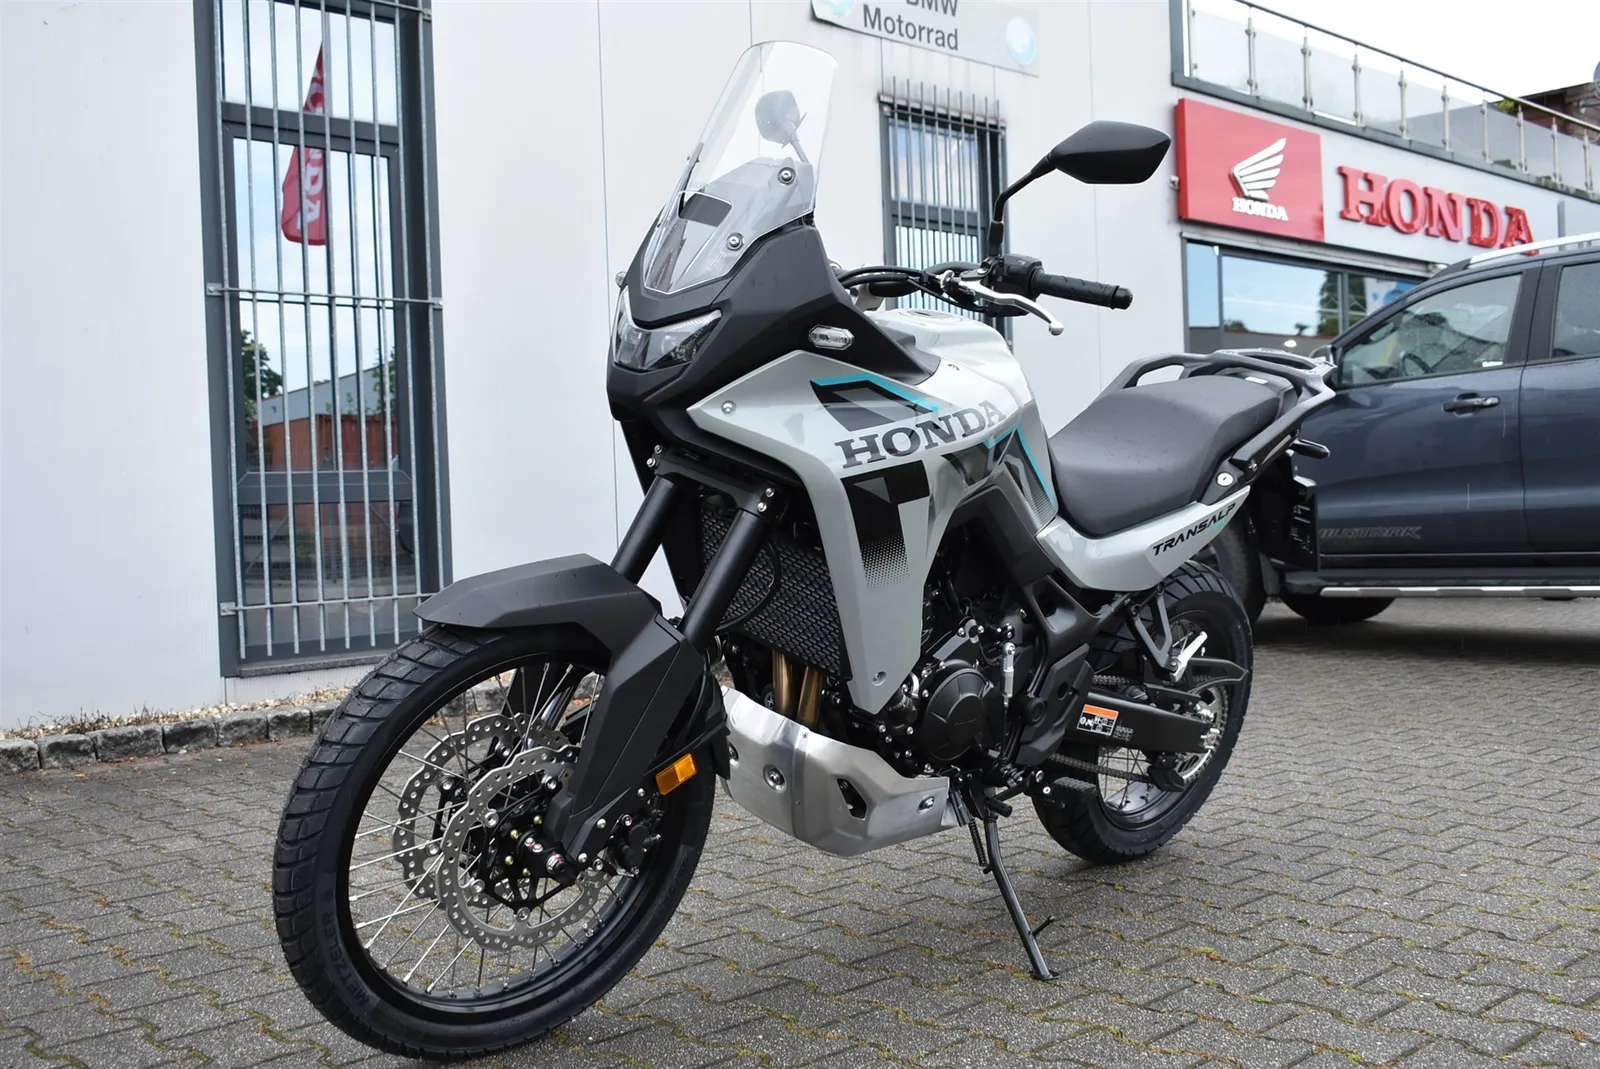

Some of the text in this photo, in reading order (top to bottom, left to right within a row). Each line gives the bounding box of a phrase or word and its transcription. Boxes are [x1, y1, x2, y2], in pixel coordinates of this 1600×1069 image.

[863, 4, 959, 51] Motorrad
[1232, 197, 1289, 221] HONDA
[1338, 166, 1540, 256] HONDA
[835, 400, 1006, 469] HONDA
[1153, 503, 1236, 556] TRANSALP
